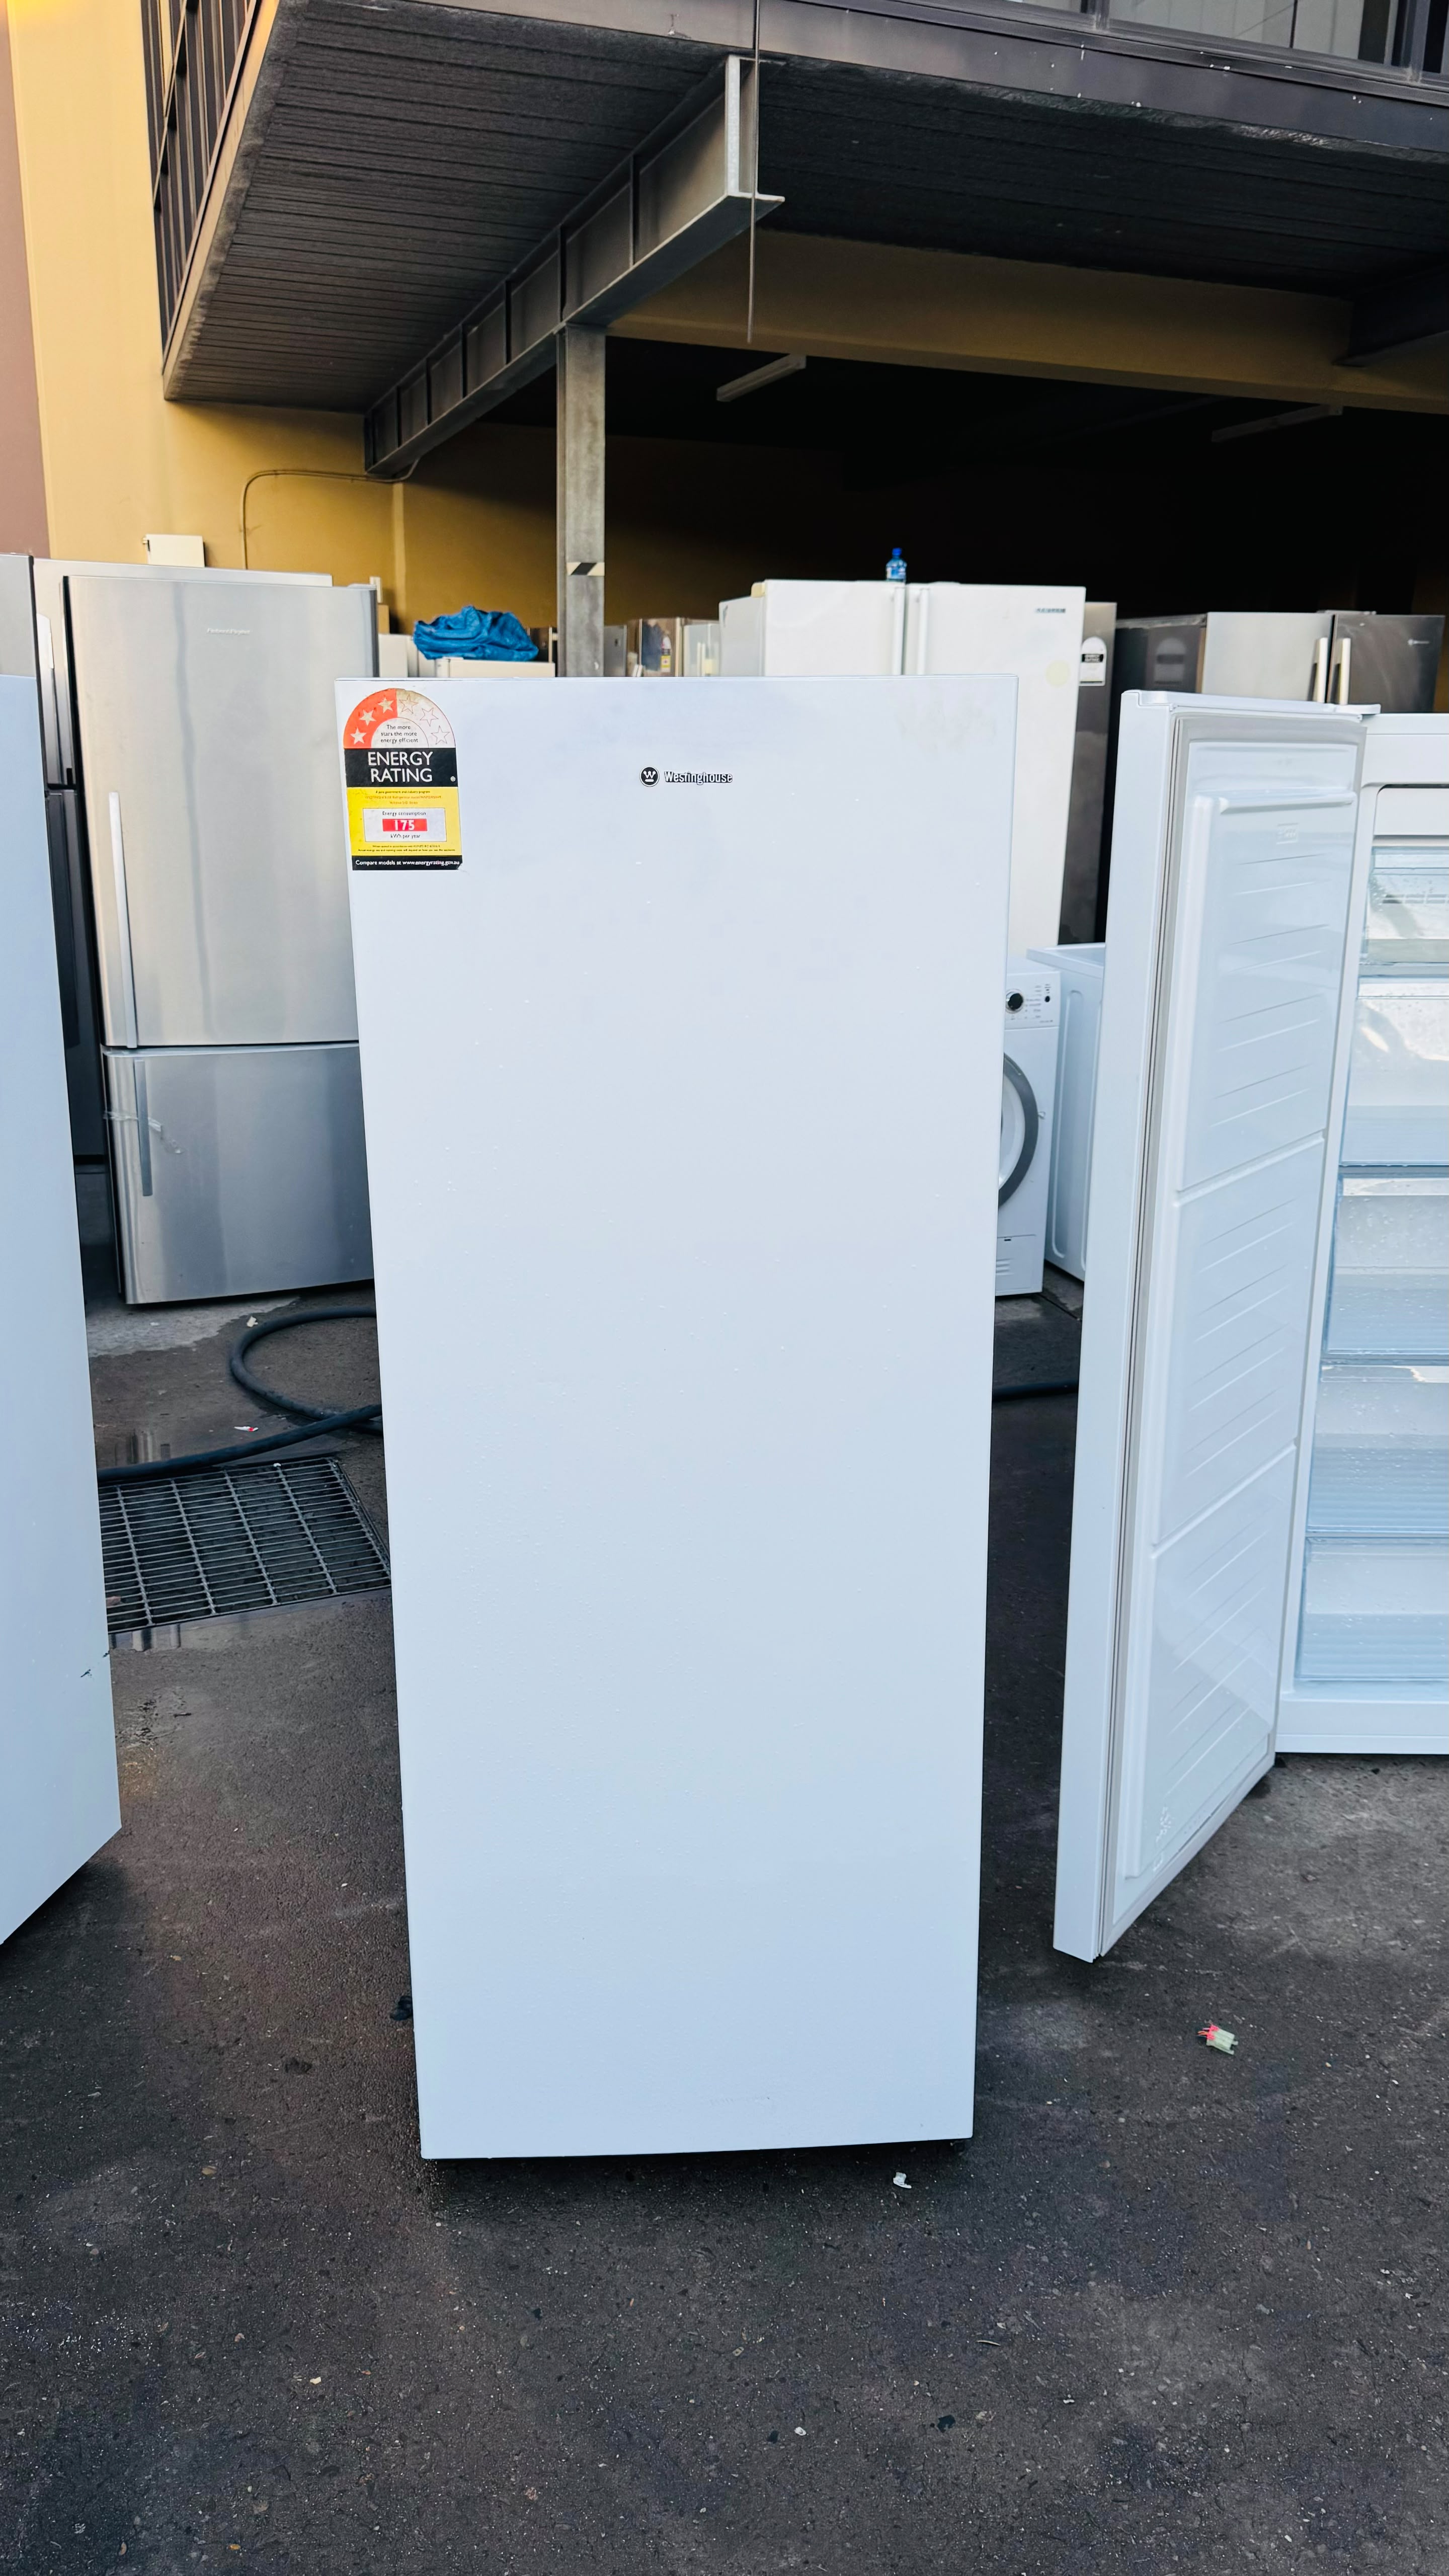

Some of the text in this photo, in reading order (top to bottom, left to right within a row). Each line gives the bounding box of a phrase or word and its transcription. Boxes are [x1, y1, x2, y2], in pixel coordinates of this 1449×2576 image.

[367, 751, 433, 766] ENERGY
[370, 768, 433, 782] RATING
[664, 771, 733, 785] Westinghouse
[394, 819, 415, 831] 175
